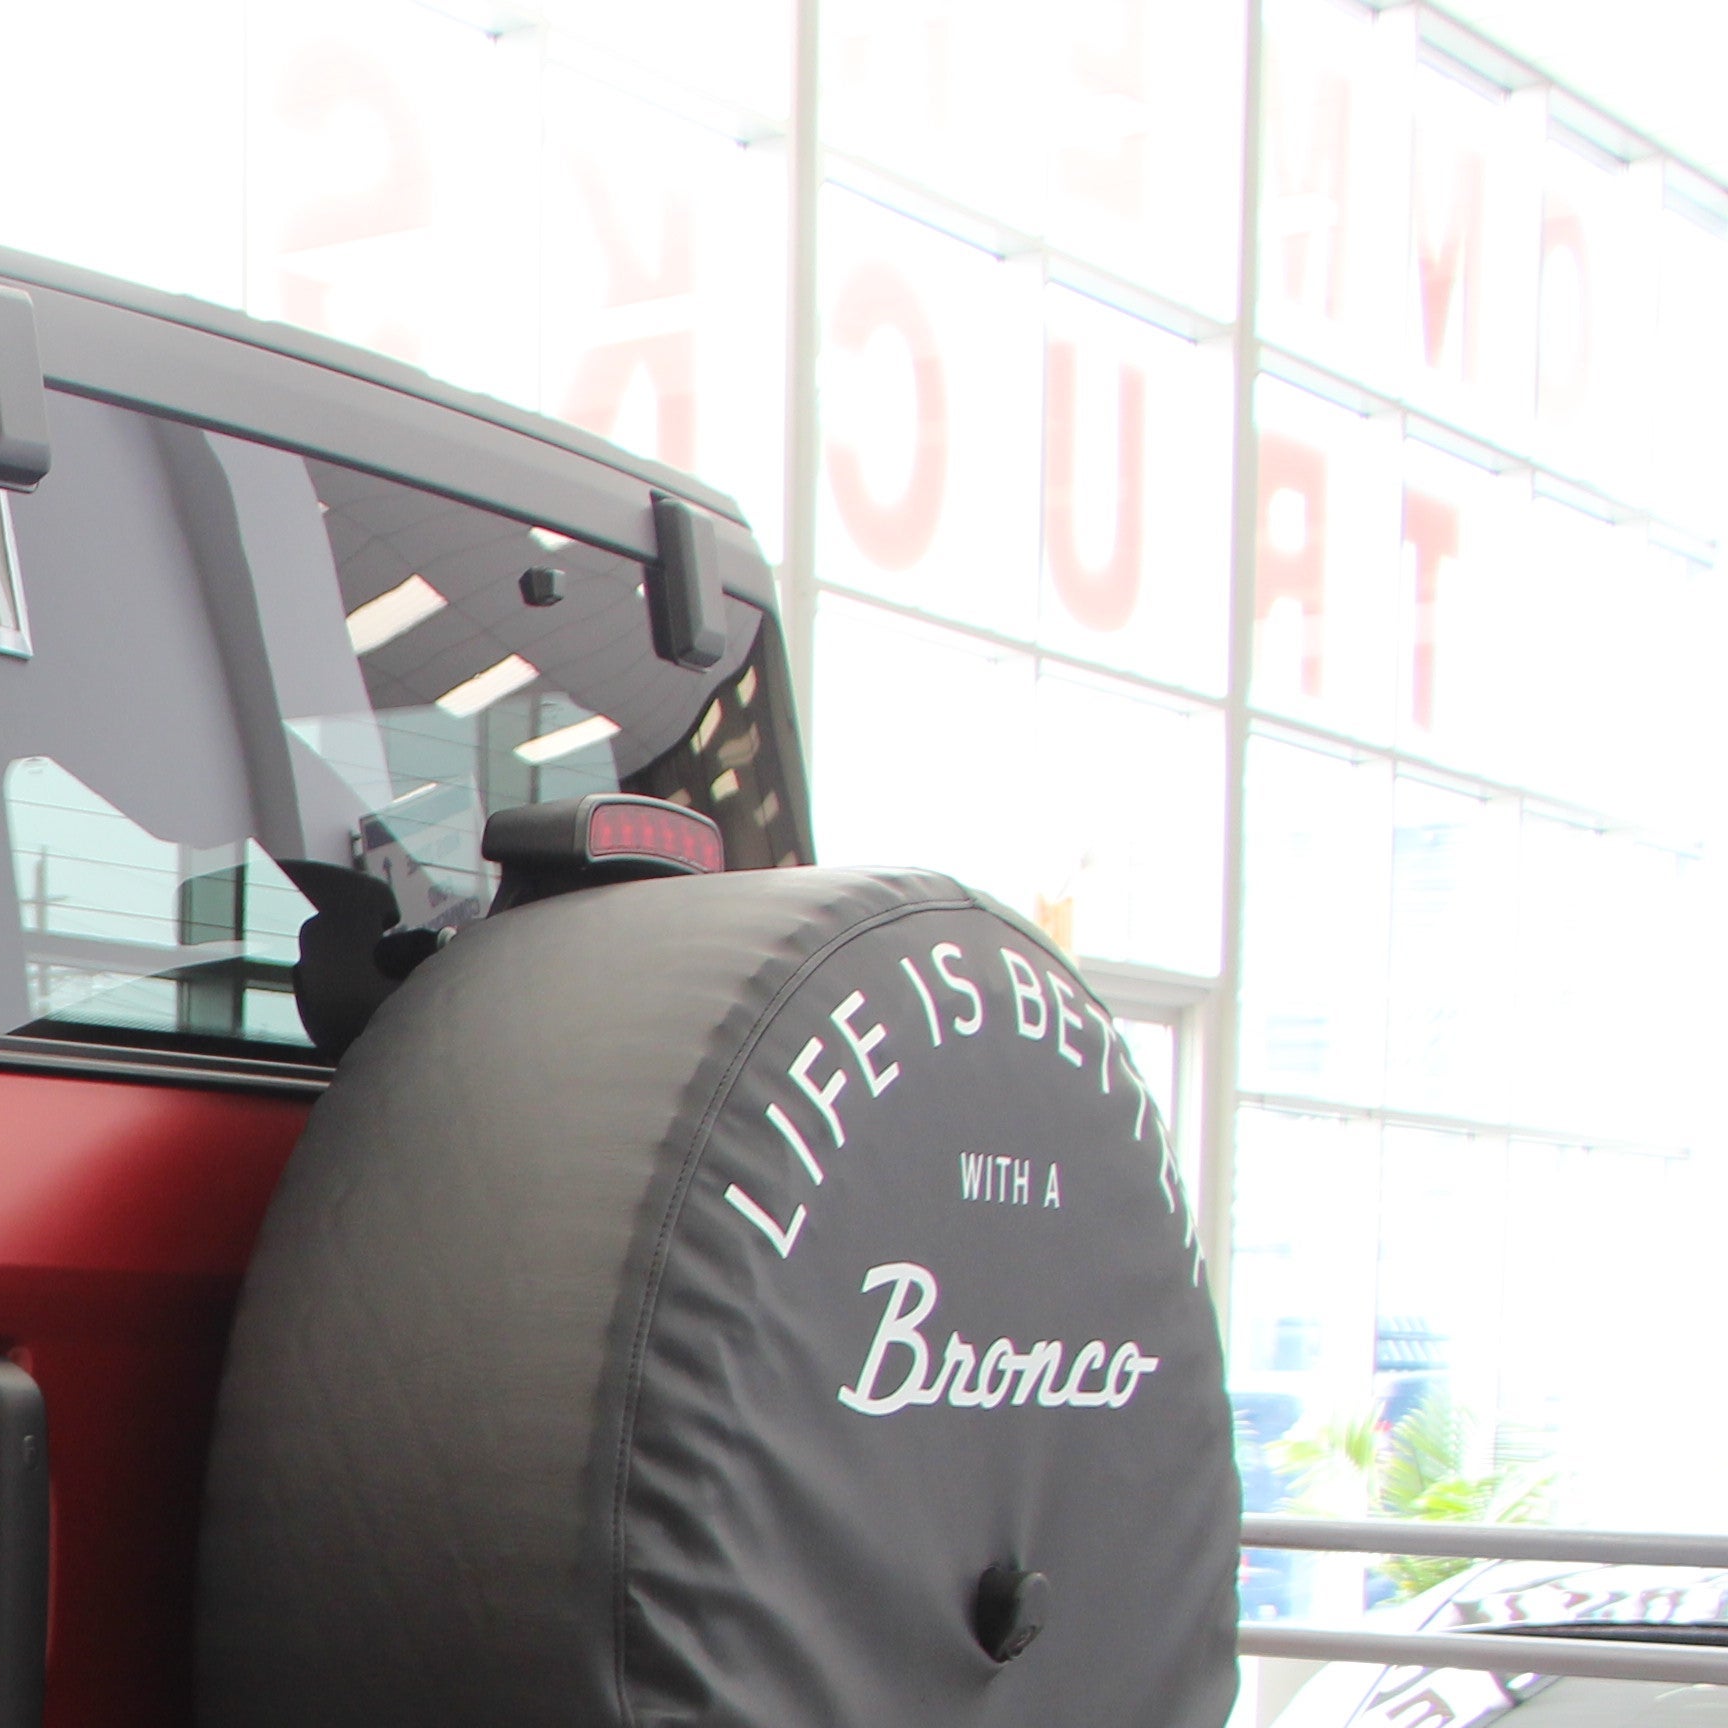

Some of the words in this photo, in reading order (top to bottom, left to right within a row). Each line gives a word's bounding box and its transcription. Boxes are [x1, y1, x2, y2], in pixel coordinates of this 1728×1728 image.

[724, 990, 900, 1259] LIFE
[898, 942, 984, 1049] IS
[959, 1151, 1030, 1205] WITH
[1043, 1162, 1061, 1209] A
[838, 1261, 1158, 1416] Bronco
